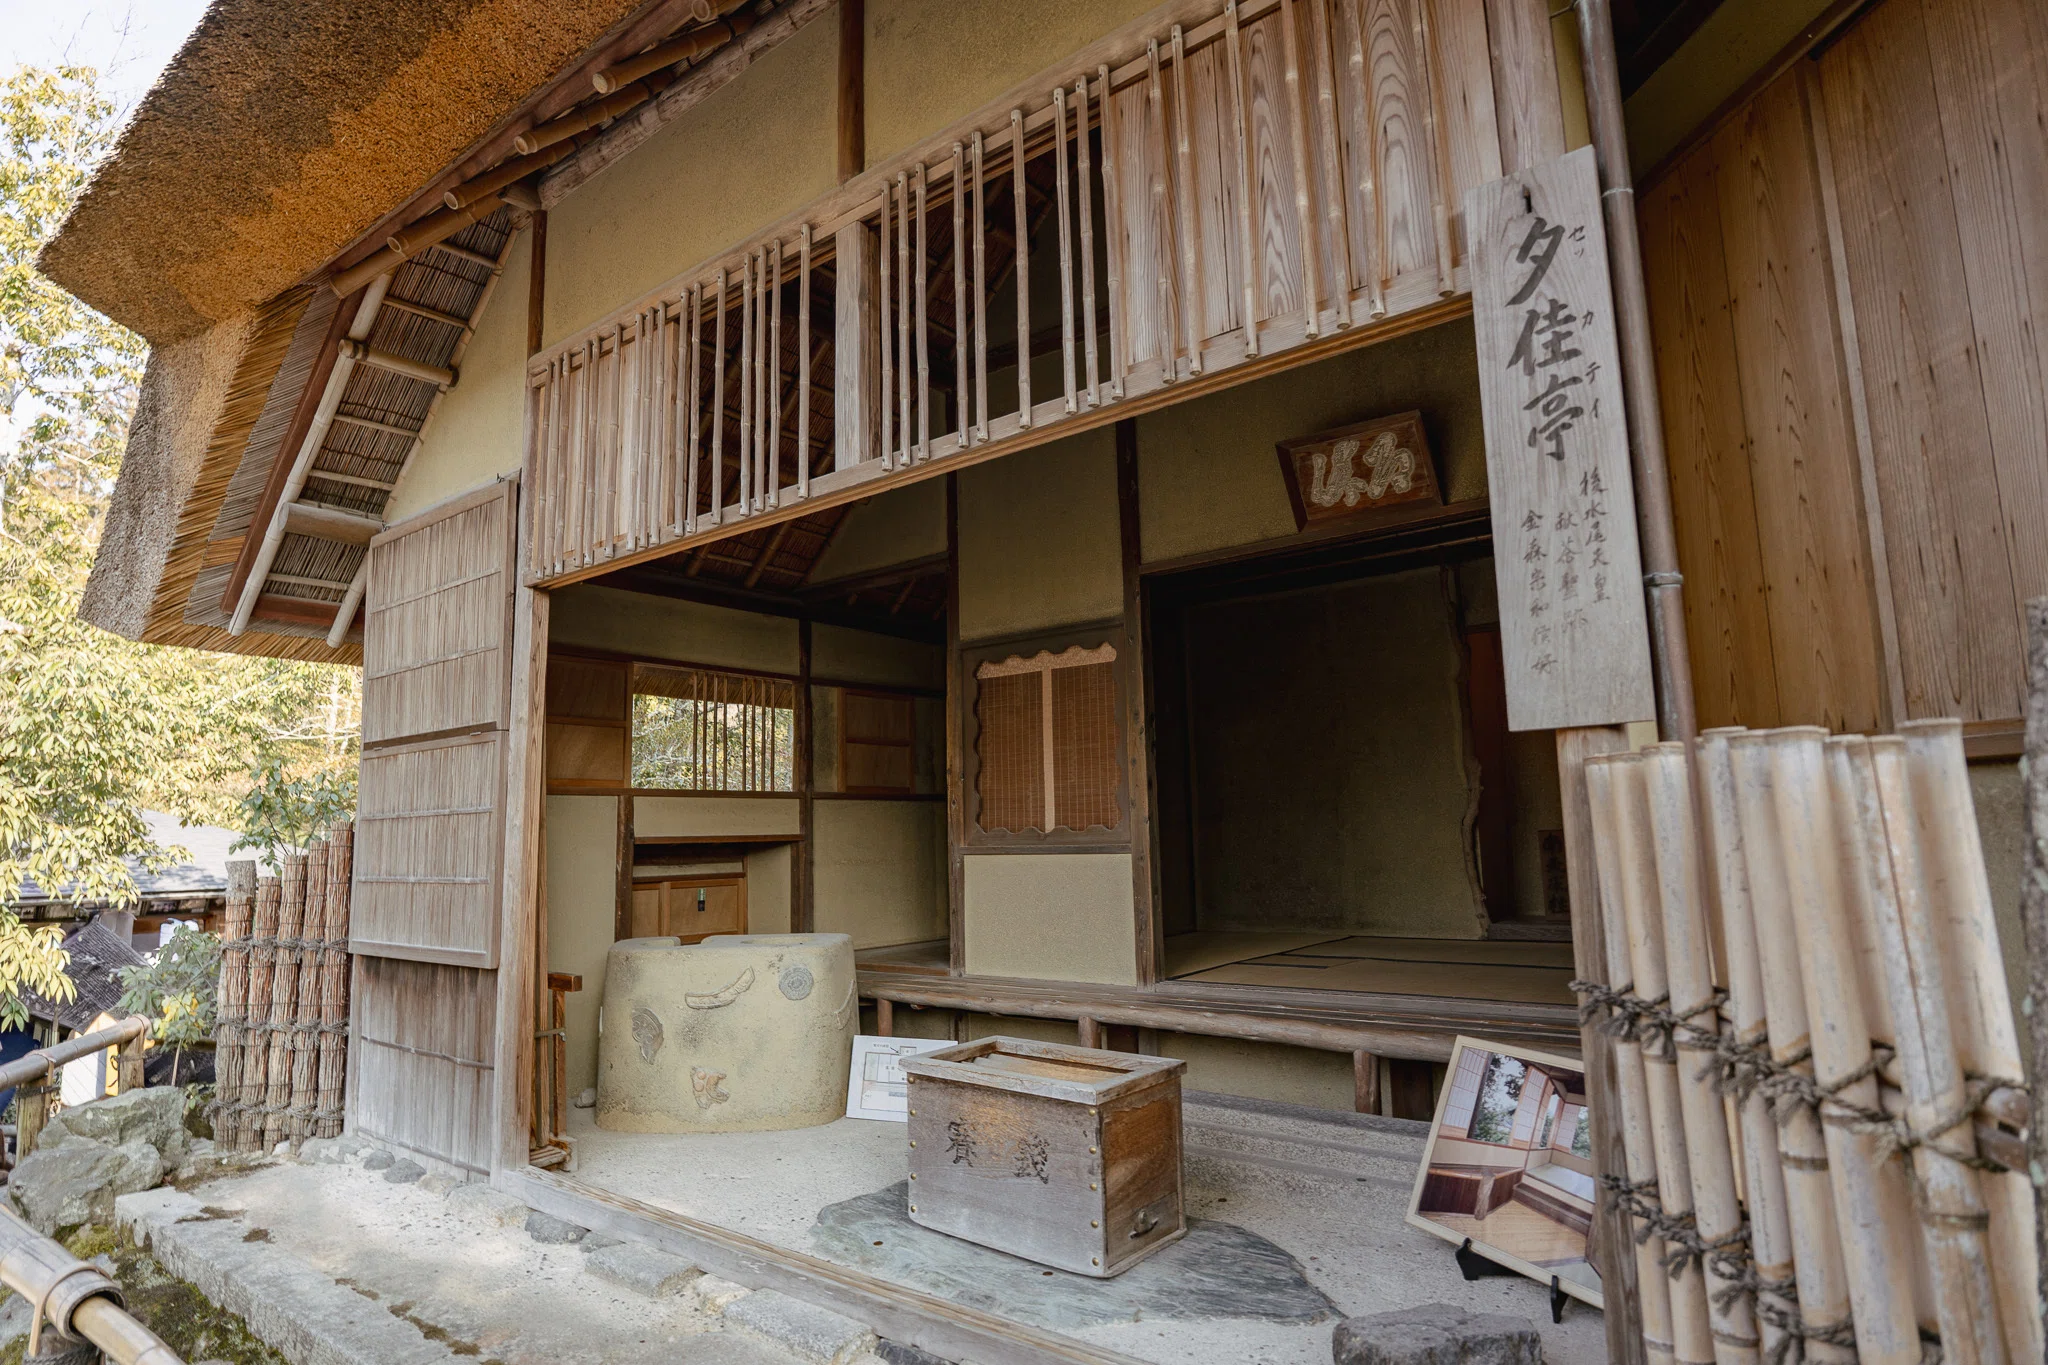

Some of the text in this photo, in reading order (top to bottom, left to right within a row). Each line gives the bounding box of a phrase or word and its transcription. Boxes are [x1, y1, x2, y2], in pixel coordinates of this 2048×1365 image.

[1505, 217, 1583, 460] 夕佳亭
[1579, 466, 1611, 604] 後水尾天皇
